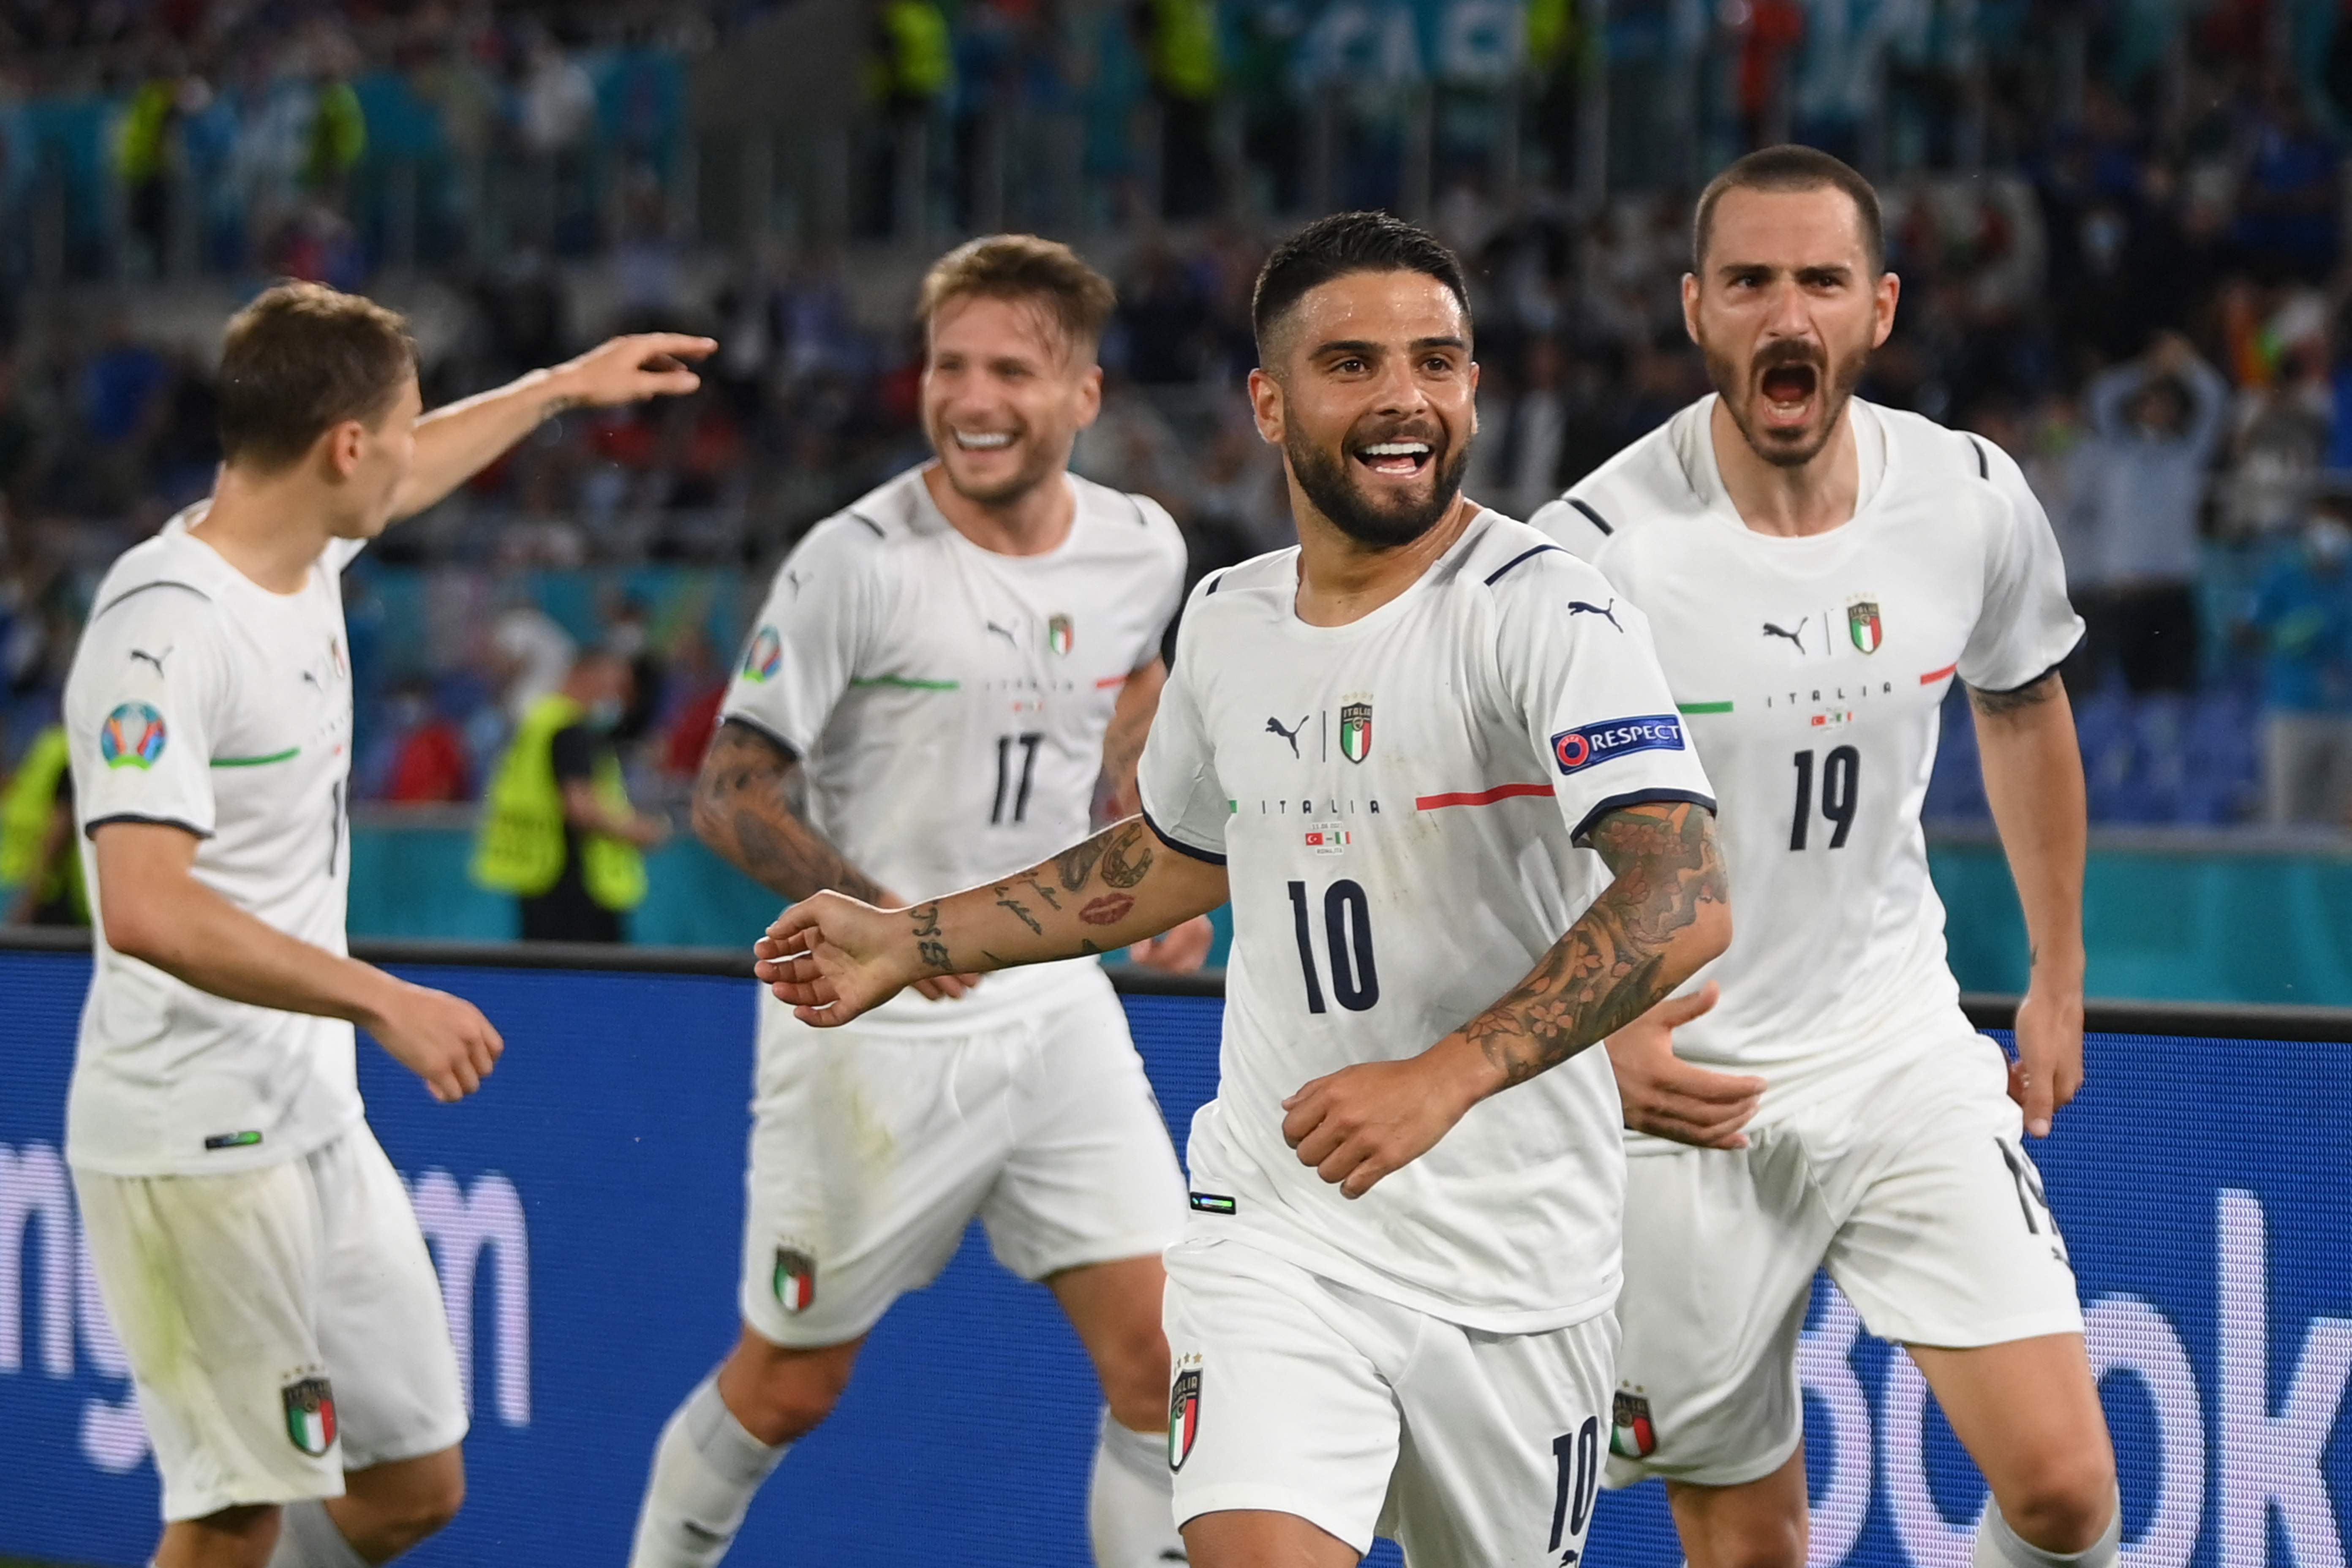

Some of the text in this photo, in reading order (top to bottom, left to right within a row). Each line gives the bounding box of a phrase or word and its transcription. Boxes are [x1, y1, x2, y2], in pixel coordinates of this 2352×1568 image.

[1343, 707, 1371, 718] ITALIA
[1767, 682, 1892, 708] ITALIA
[1590, 724, 1679, 751] RESPECT
[991, 732, 1046, 825] 17
[1261, 799, 1380, 814] ITALIA
[1790, 745, 1860, 851] 19
[1287, 879, 1380, 1014] 10
[1548, 1416, 1598, 1554] 10
